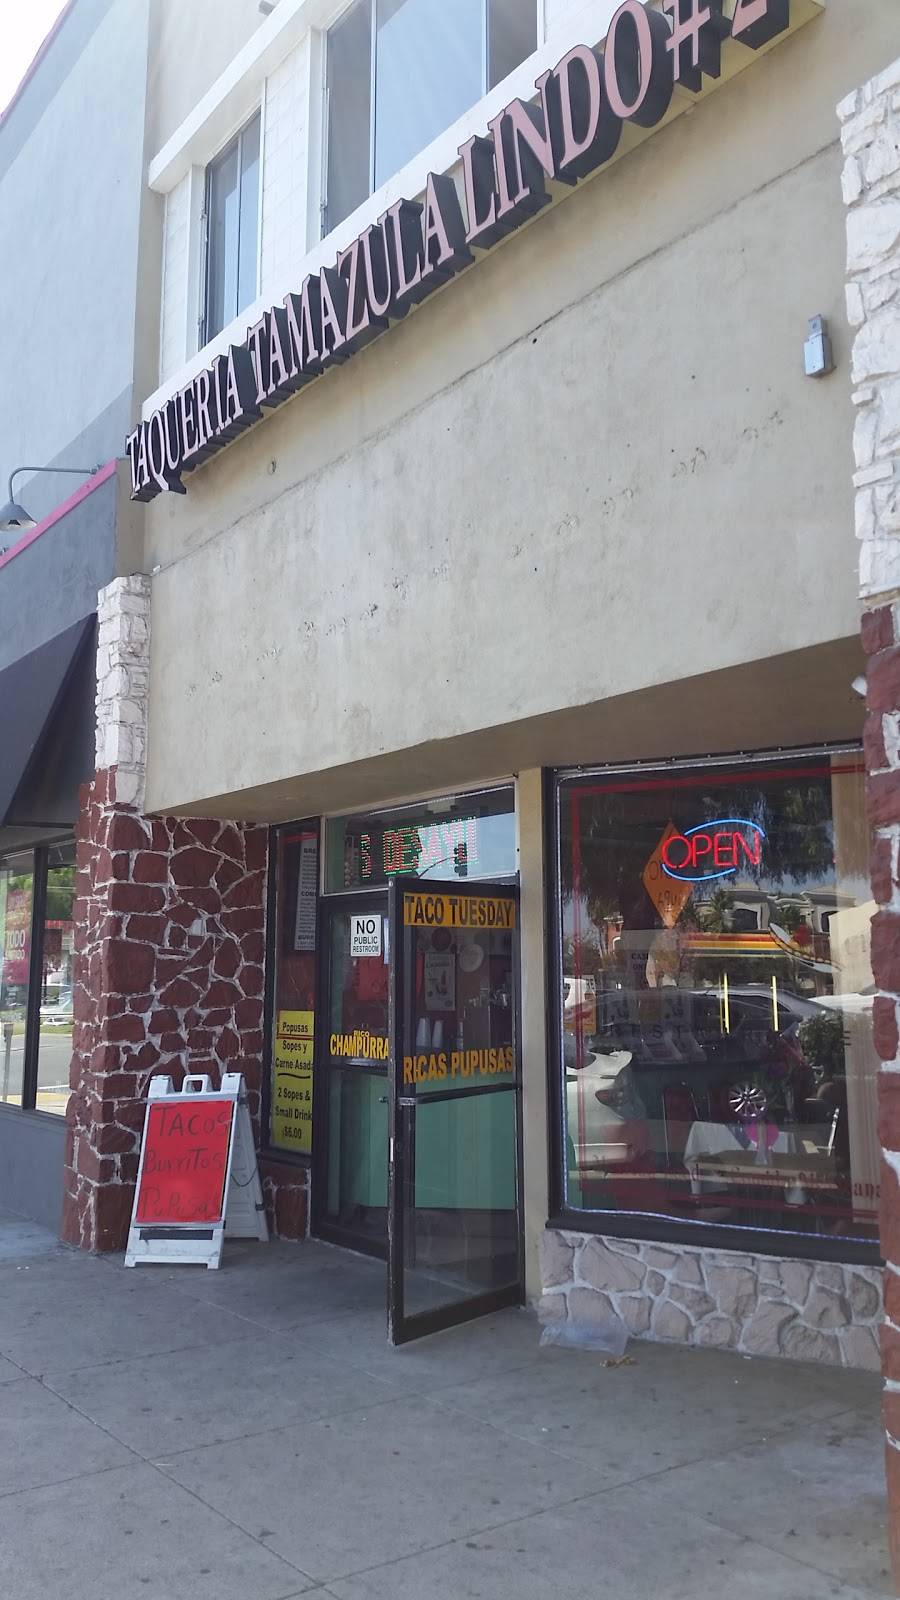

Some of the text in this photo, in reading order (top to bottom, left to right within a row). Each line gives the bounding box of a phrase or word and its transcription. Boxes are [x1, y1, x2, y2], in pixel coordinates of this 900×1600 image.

[126, 345, 244, 491] TAQUERIA
[248, 172, 454, 405] TAMAZULA
[457, 0, 653, 244] LINDO
[661, 831, 761, 870] OPEN
[404, 895, 513, 927] TACO TUESDAY
[356, 919, 376, 934] NO
[353, 936, 378, 945] PUBLIC
[352, 945, 379, 953] RESTROOM
[282, 1040, 308, 1054] Sopes y
[330, 1034, 389, 1060] CHAMPURRA
[275, 1057, 294, 1069] Carne
[403, 1046, 513, 1084] RICAS PUPUSAS
[277, 1087, 311, 1101] 2 Sopes &
[275, 1105, 293, 1118] Small
